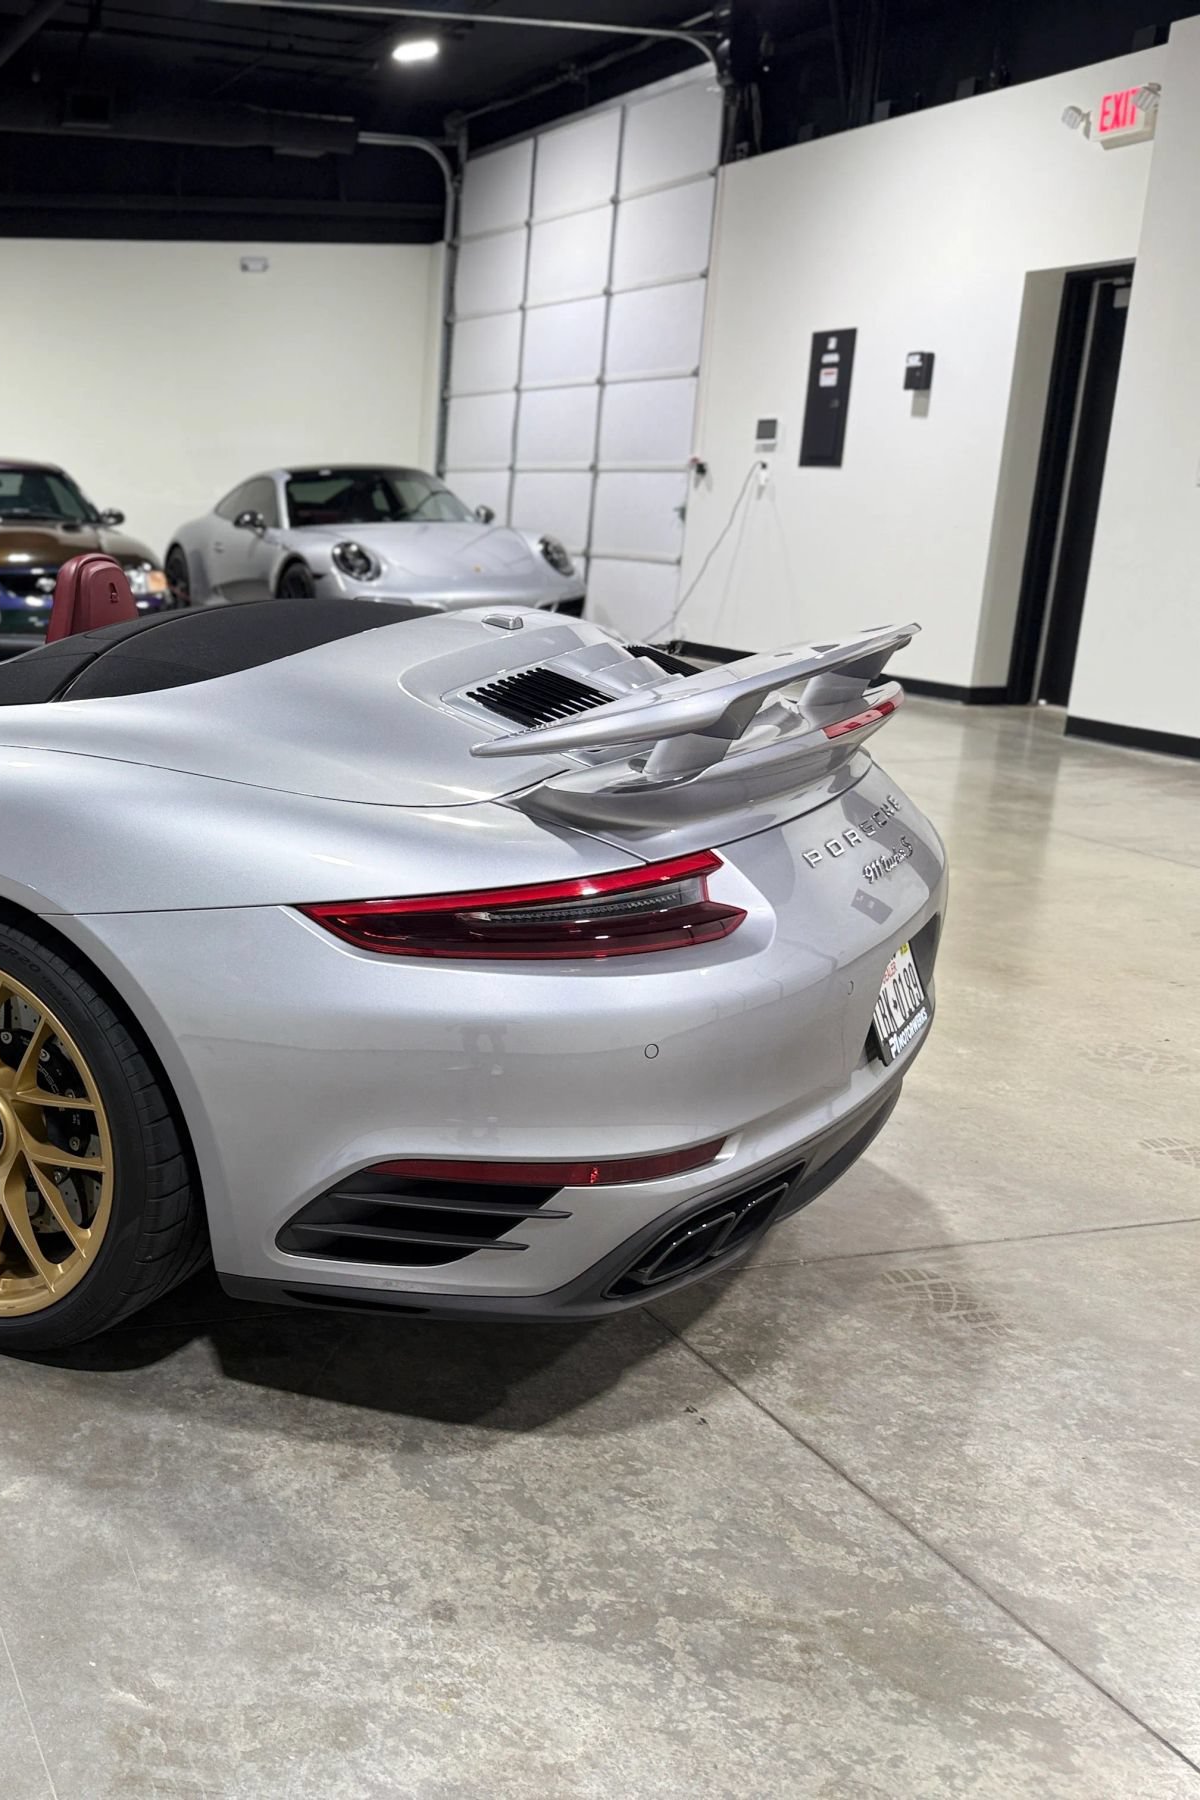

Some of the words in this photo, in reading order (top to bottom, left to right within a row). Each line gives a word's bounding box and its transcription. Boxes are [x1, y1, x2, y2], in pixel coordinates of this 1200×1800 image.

[1099, 88, 1140, 133] EXIT
[803, 795, 901, 868] PORSCHE
[862, 859, 883, 883] 911
